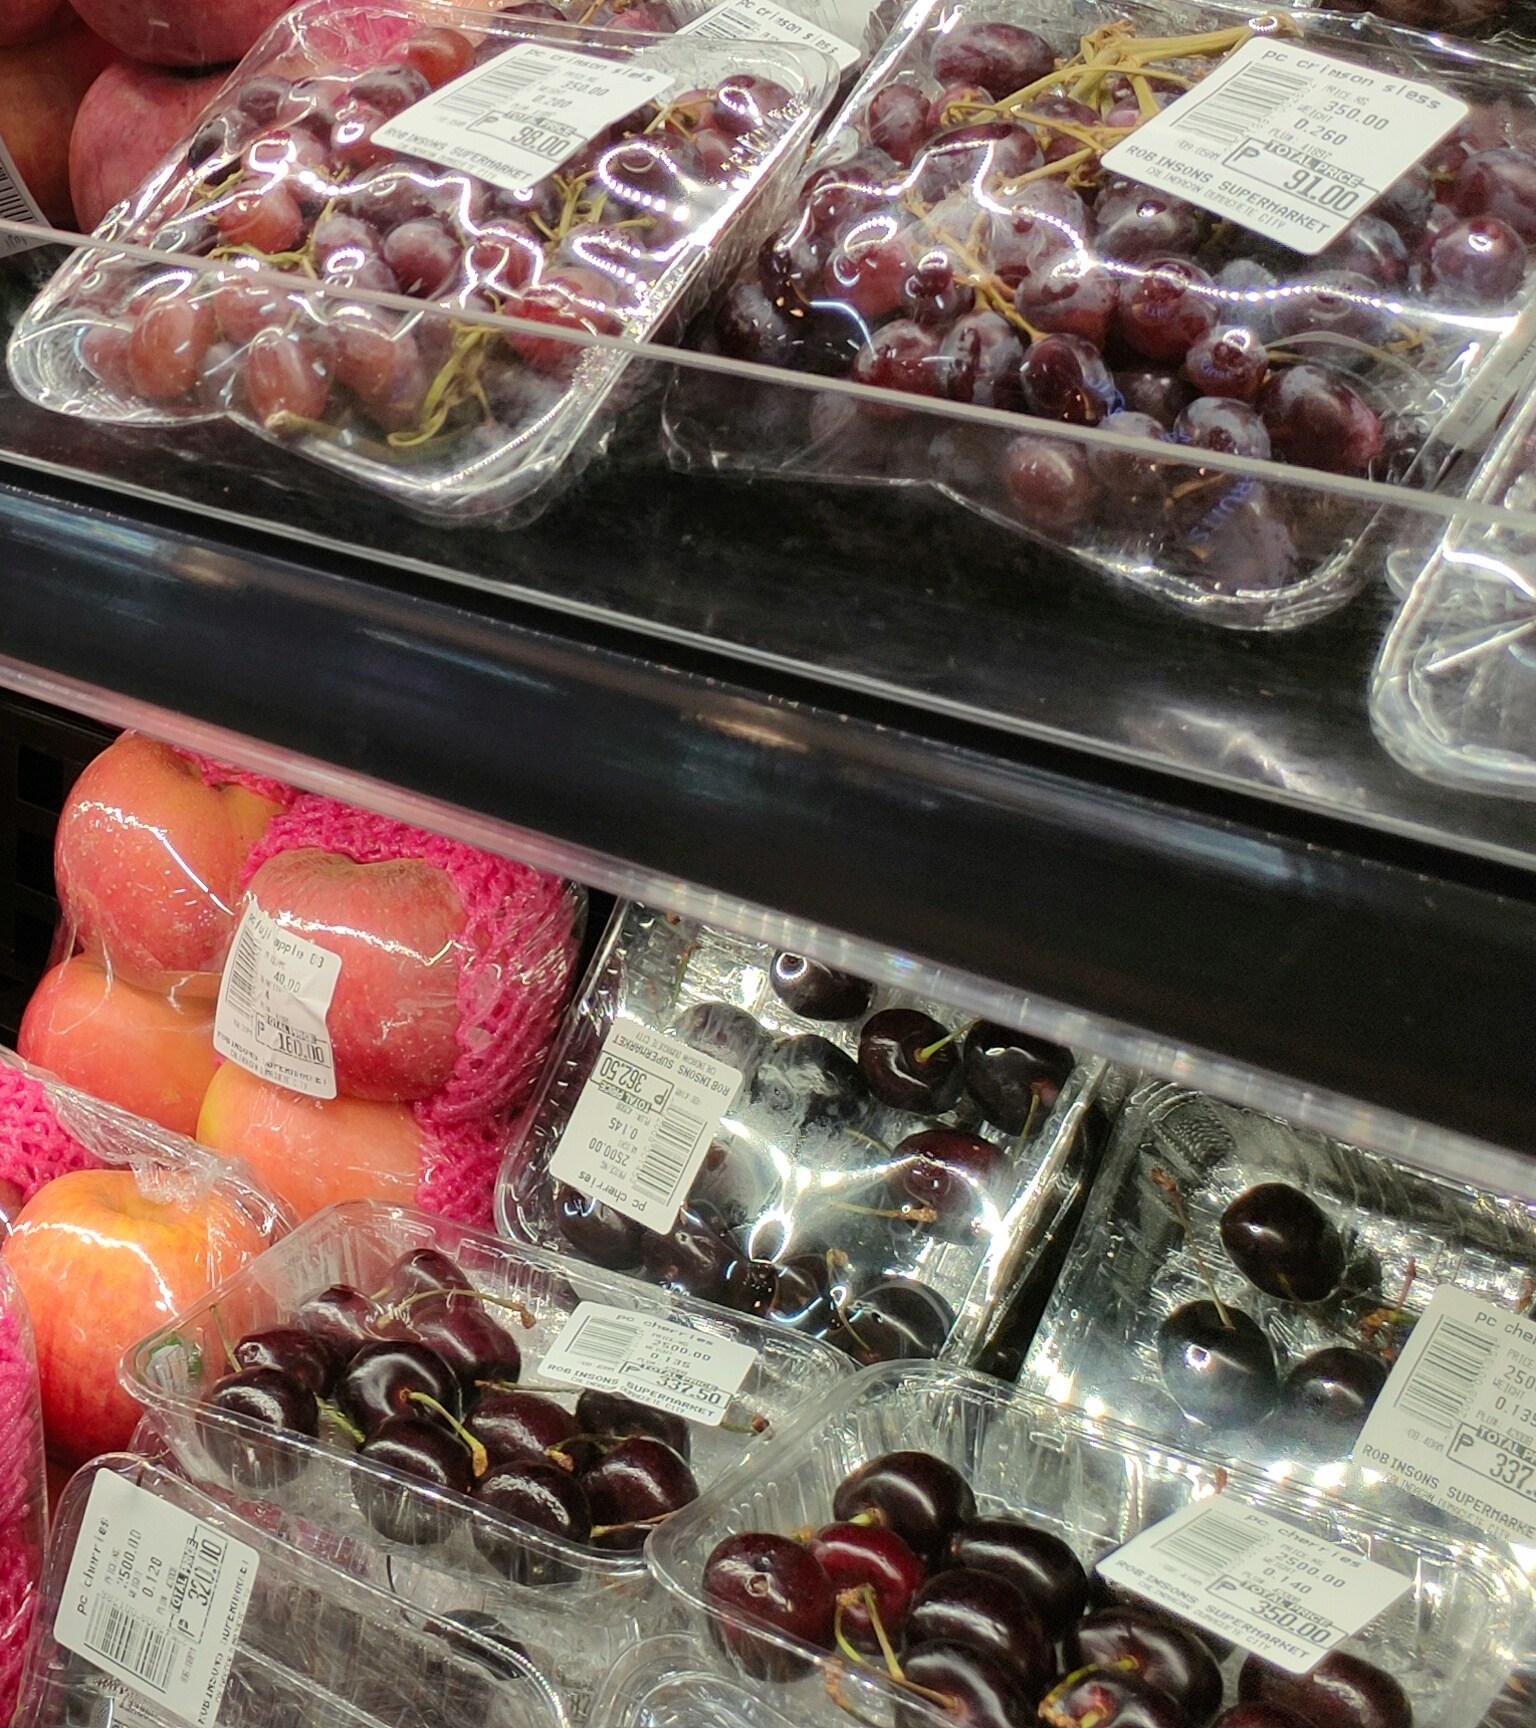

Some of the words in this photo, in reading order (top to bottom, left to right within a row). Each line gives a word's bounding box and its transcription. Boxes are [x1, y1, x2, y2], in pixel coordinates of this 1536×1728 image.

[524, 48, 544, 58] pc
[560, 79, 610, 97] 350.00
[1261, 49, 1288, 64] pc
[1295, 60, 1376, 86] crimson
[1381, 80, 1442, 111] sless
[540, 120, 577, 136] PRICE
[1322, 99, 1390, 131] 350.00
[511, 125, 570, 157] 98.00
[1293, 118, 1349, 147] 0.260
[449, 146, 533, 181] SUPERMARKET
[1266, 140, 1315, 168] TOTAL
[1316, 159, 1361, 186] PRICE
[1217, 179, 1331, 234] SUPERMARKET
[1283, 168, 1360, 214] 91.00
[611, 1033, 676, 1070] SUPERMARKET
[598, 1057, 648, 1094] 362.50
[598, 1081, 624, 1099] PRICE
[623, 1095, 652, 1113] TOTAL
[607, 1117, 640, 1140] 0.145
[587, 1138, 630, 1167] 2500.00
[577, 1168, 629, 1201] cherries
[630, 1200, 648, 1212] pc
[614, 1313, 636, 1322] pc
[642, 1319, 715, 1346] cherries
[1474, 1311, 1497, 1328] pc
[625, 1382, 716, 1418] SUPERMARKET
[656, 1375, 723, 1405] 337.50
[1492, 1378, 1526, 1398] WEIGHT
[1479, 1427, 1521, 1457] TOTAL
[1244, 1513, 1270, 1527] pc
[1277, 1527, 1363, 1569] cherries
[1261, 1565, 1313, 1595] 0.140
[1272, 1553, 1347, 1589] 2500.00
[75, 1593, 89, 1616] pc
[1206, 1604, 1310, 1659] SUPERMARKET
[1250, 1599, 1331, 1644] 350.00
